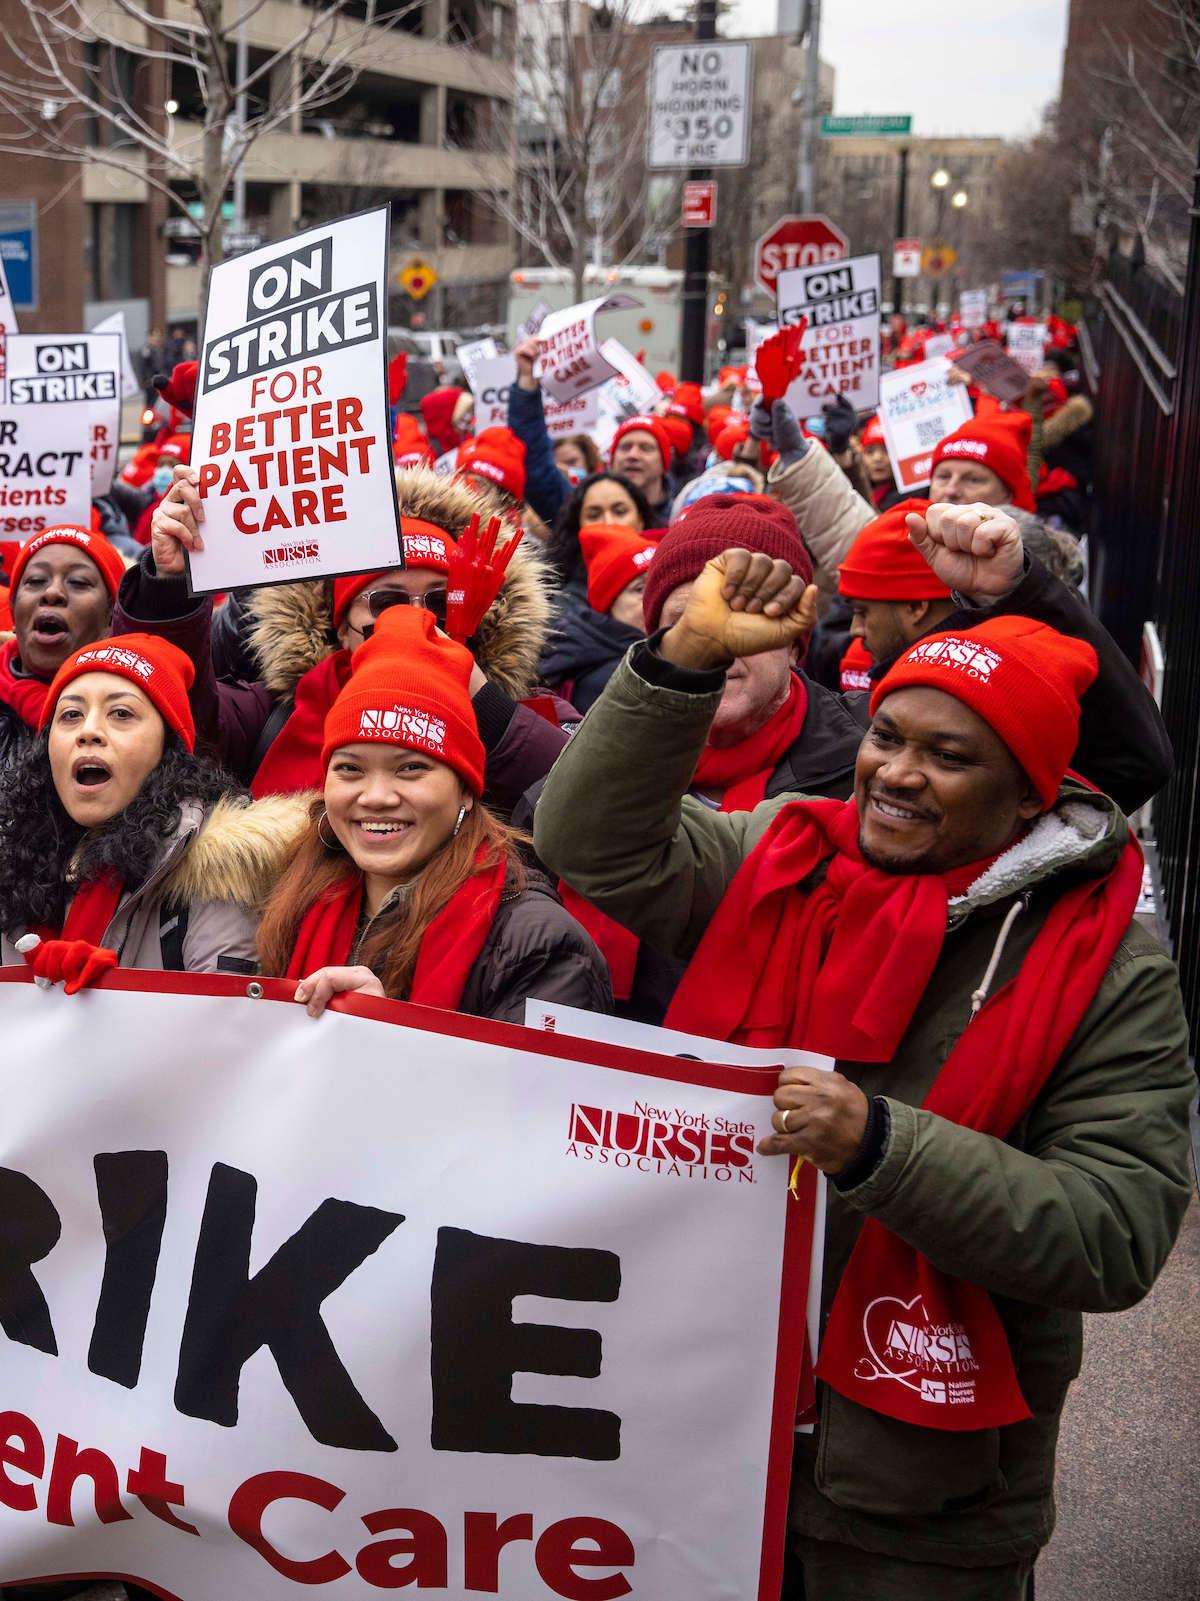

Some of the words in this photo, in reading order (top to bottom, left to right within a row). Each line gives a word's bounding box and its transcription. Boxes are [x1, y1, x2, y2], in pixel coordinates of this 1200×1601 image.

[681, 51, 721, 74] NO
[252, 248, 322, 310] ON
[807, 269, 849, 299] ON
[784, 291, 876, 327] STRIKE
[207, 291, 373, 386] STRIKE
[541, 319, 586, 354] BETTER
[815, 323, 853, 343] FOR
[38, 345, 86, 373] ON
[541, 333, 590, 374] PATIENT
[809, 338, 871, 362] ETTER
[554, 356, 591, 383] CARE
[803, 354, 874, 382] ATIENT
[11, 374, 115, 404] STRIKE
[251, 366, 322, 408] FOR
[808, 375, 861, 397] CARE
[209, 397, 364, 457] BETTER
[199, 436, 376, 499] PATIENT
[233, 484, 347, 534] CARE
[262, 544, 320, 564] NURSES
[403, 538, 447, 557] RSES
[403, 551, 448, 562] CIATION
[264, 557, 322, 570] ASSOCIATION
[75, 649, 154, 678] NURSES
[907, 641, 1000, 676] NURSES
[964, 639, 982, 651] York
[982, 646, 1003, 662] State
[359, 709, 447, 746] NURSES
[393, 704, 412, 714] New
[414, 708, 430, 720] York
[431, 715, 447, 728] State
[358, 728, 445, 755] ASSOCIATION
[633, 1100, 671, 1122] New
[674, 1108, 710, 1131] York
[714, 1117, 755, 1136] State
[567, 1103, 755, 1170] NURSES
[565, 1141, 756, 1184] ASSOCIATION
[930, 1323, 955, 1336] York
[948, 1380, 975, 1389] National
[948, 1388, 975, 1397] Nurses
[948, 1396, 976, 1405] United
[227, 1470, 636, 1601] Care
